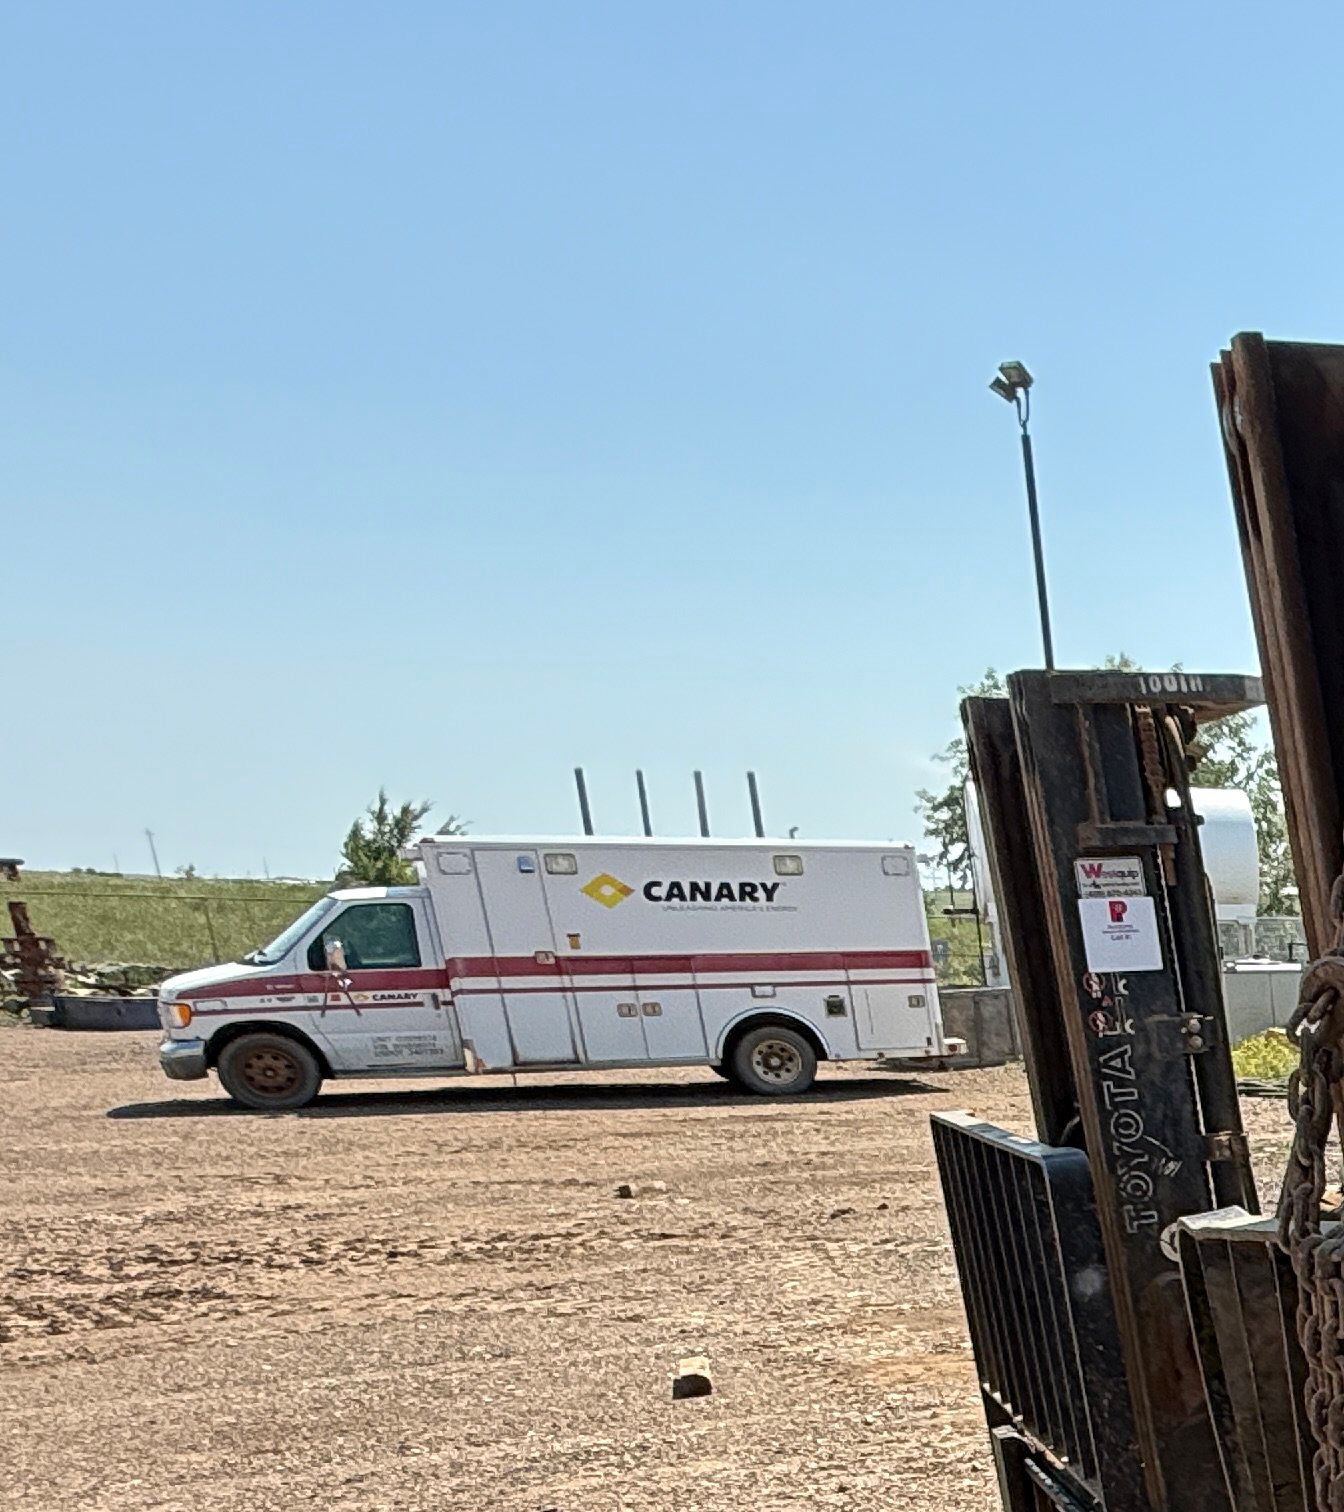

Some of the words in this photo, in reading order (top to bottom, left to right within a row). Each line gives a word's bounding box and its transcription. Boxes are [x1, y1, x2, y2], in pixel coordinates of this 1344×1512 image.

[642, 880, 780, 902] CANARY
[372, 992, 419, 1002] CANARY
[1099, 1045, 1158, 1234] TOYOTA
